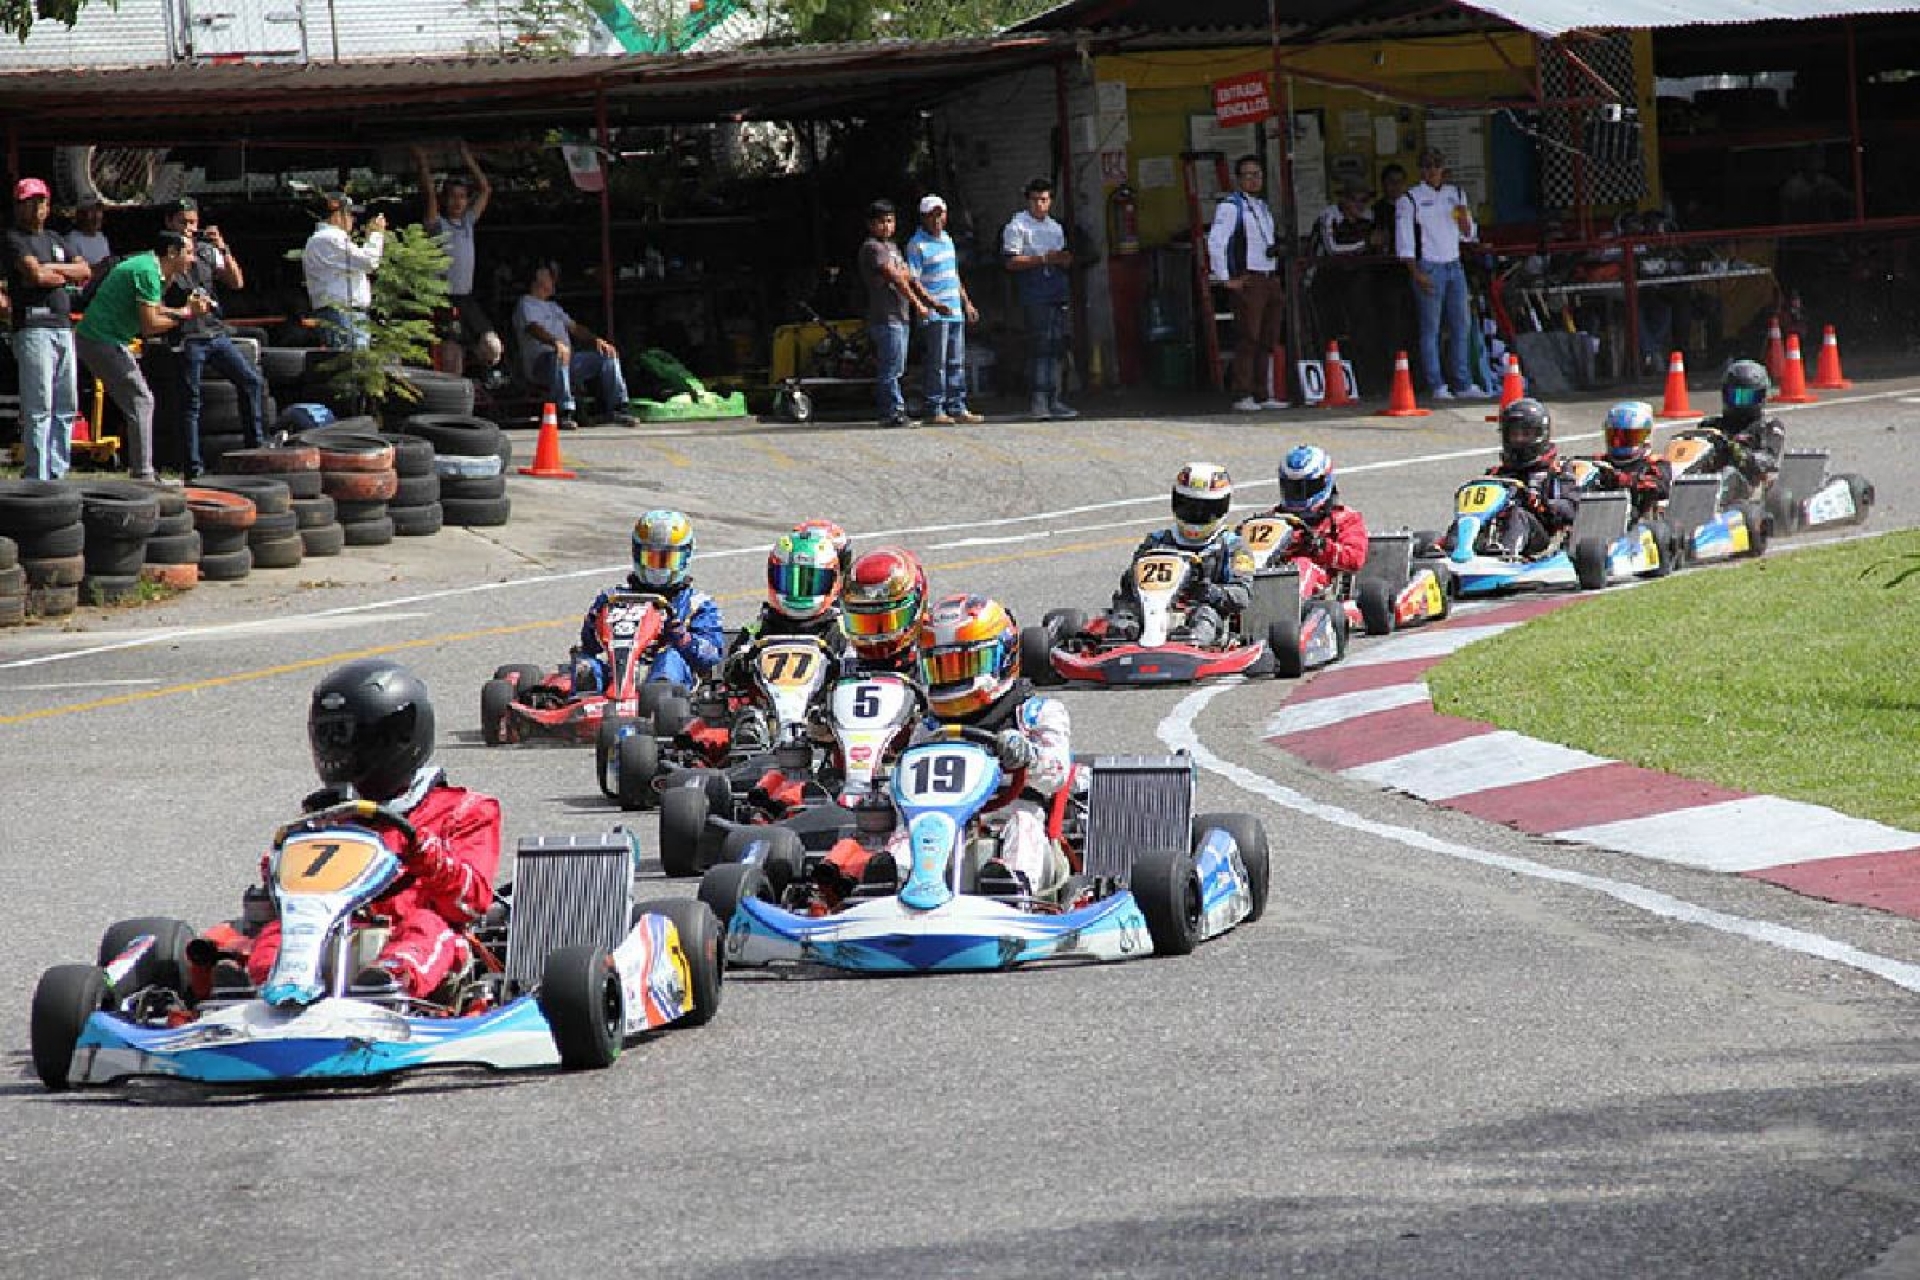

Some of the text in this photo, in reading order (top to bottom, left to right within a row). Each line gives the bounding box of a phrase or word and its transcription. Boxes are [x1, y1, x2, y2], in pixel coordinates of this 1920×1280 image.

[1217, 82, 1264, 103] ENTRADA
[1463, 486, 1487, 507] 16
[1248, 524, 1273, 543] 12
[1143, 562, 1173, 583] 25
[766, 653, 812, 683] 77
[852, 685, 881, 717] 5
[909, 754, 966, 795] 19
[301, 844, 340, 878] 7
